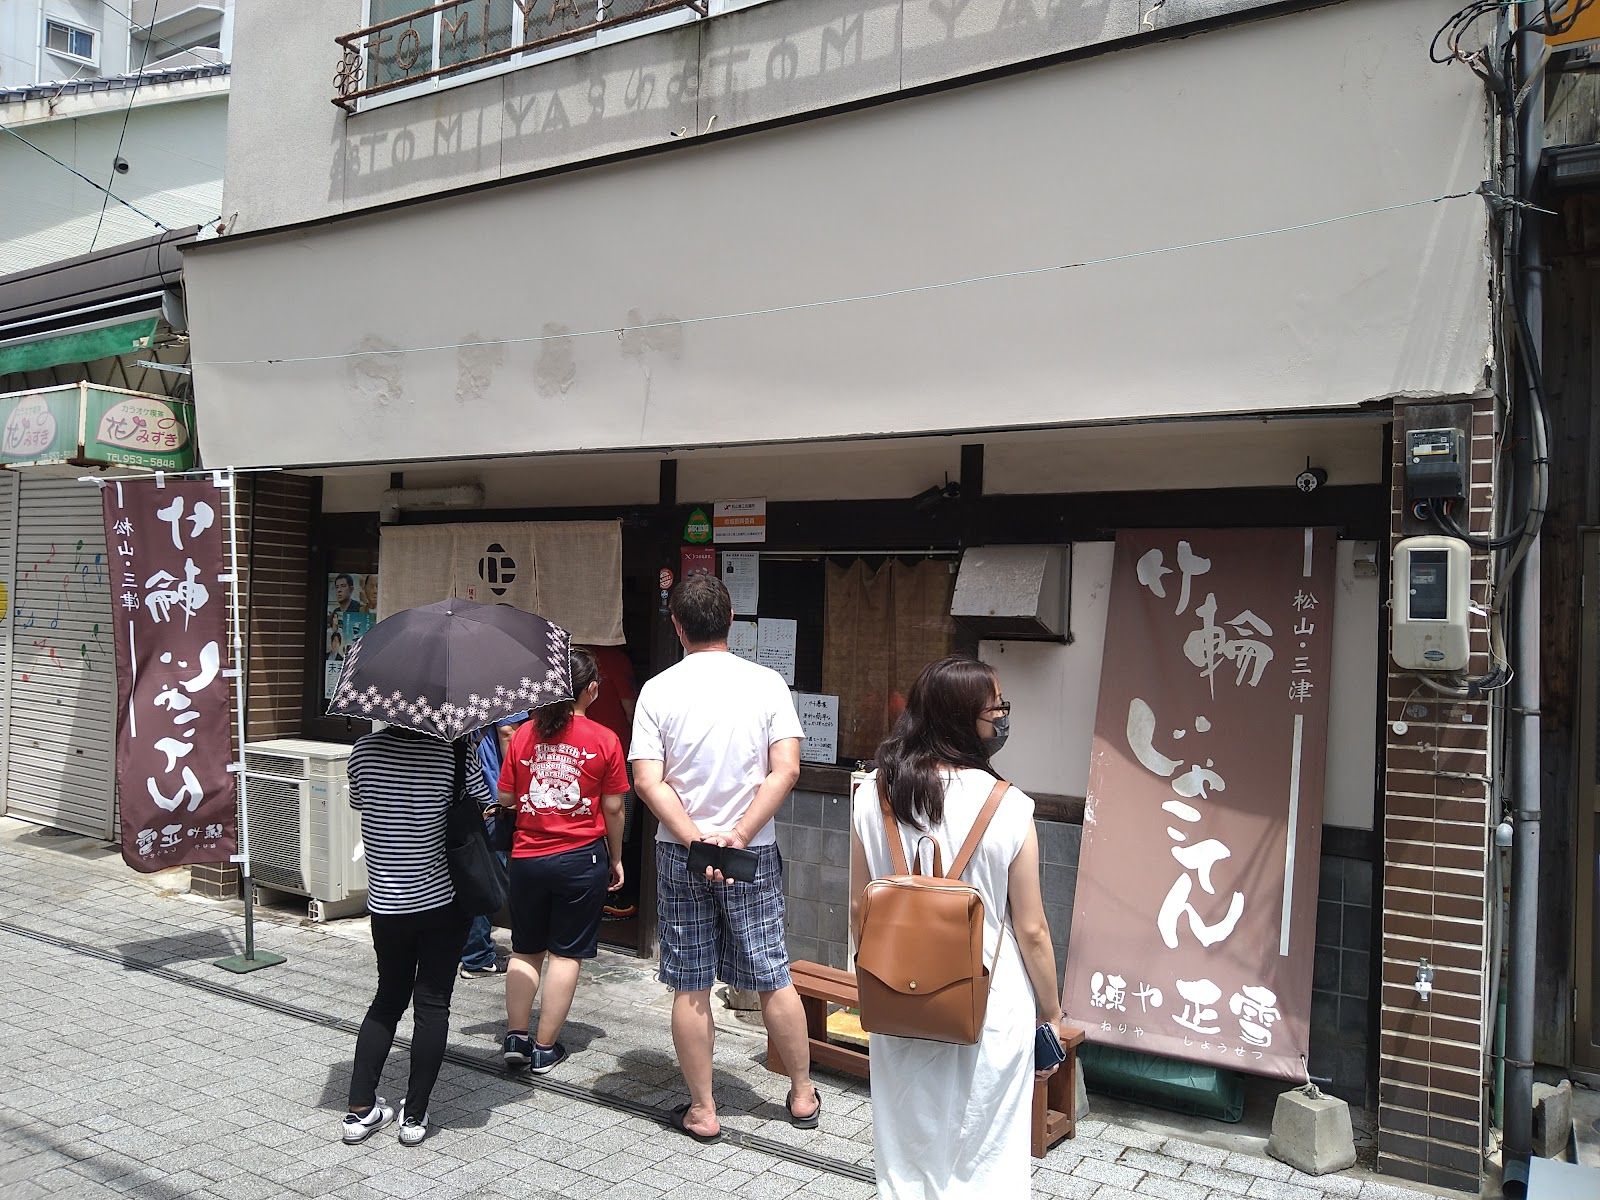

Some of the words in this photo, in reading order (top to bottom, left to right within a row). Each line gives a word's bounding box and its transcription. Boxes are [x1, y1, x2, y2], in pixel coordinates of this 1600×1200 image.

[106, 416, 178, 447] 花みずき
[1288, 589, 1319, 703] 松山・三津
[536, 744, 556, 752] The
[538, 770, 575, 782] Marathon
[1100, 1022, 1144, 1038] ねりや
[1183, 1036, 1263, 1059] しょうせつ
